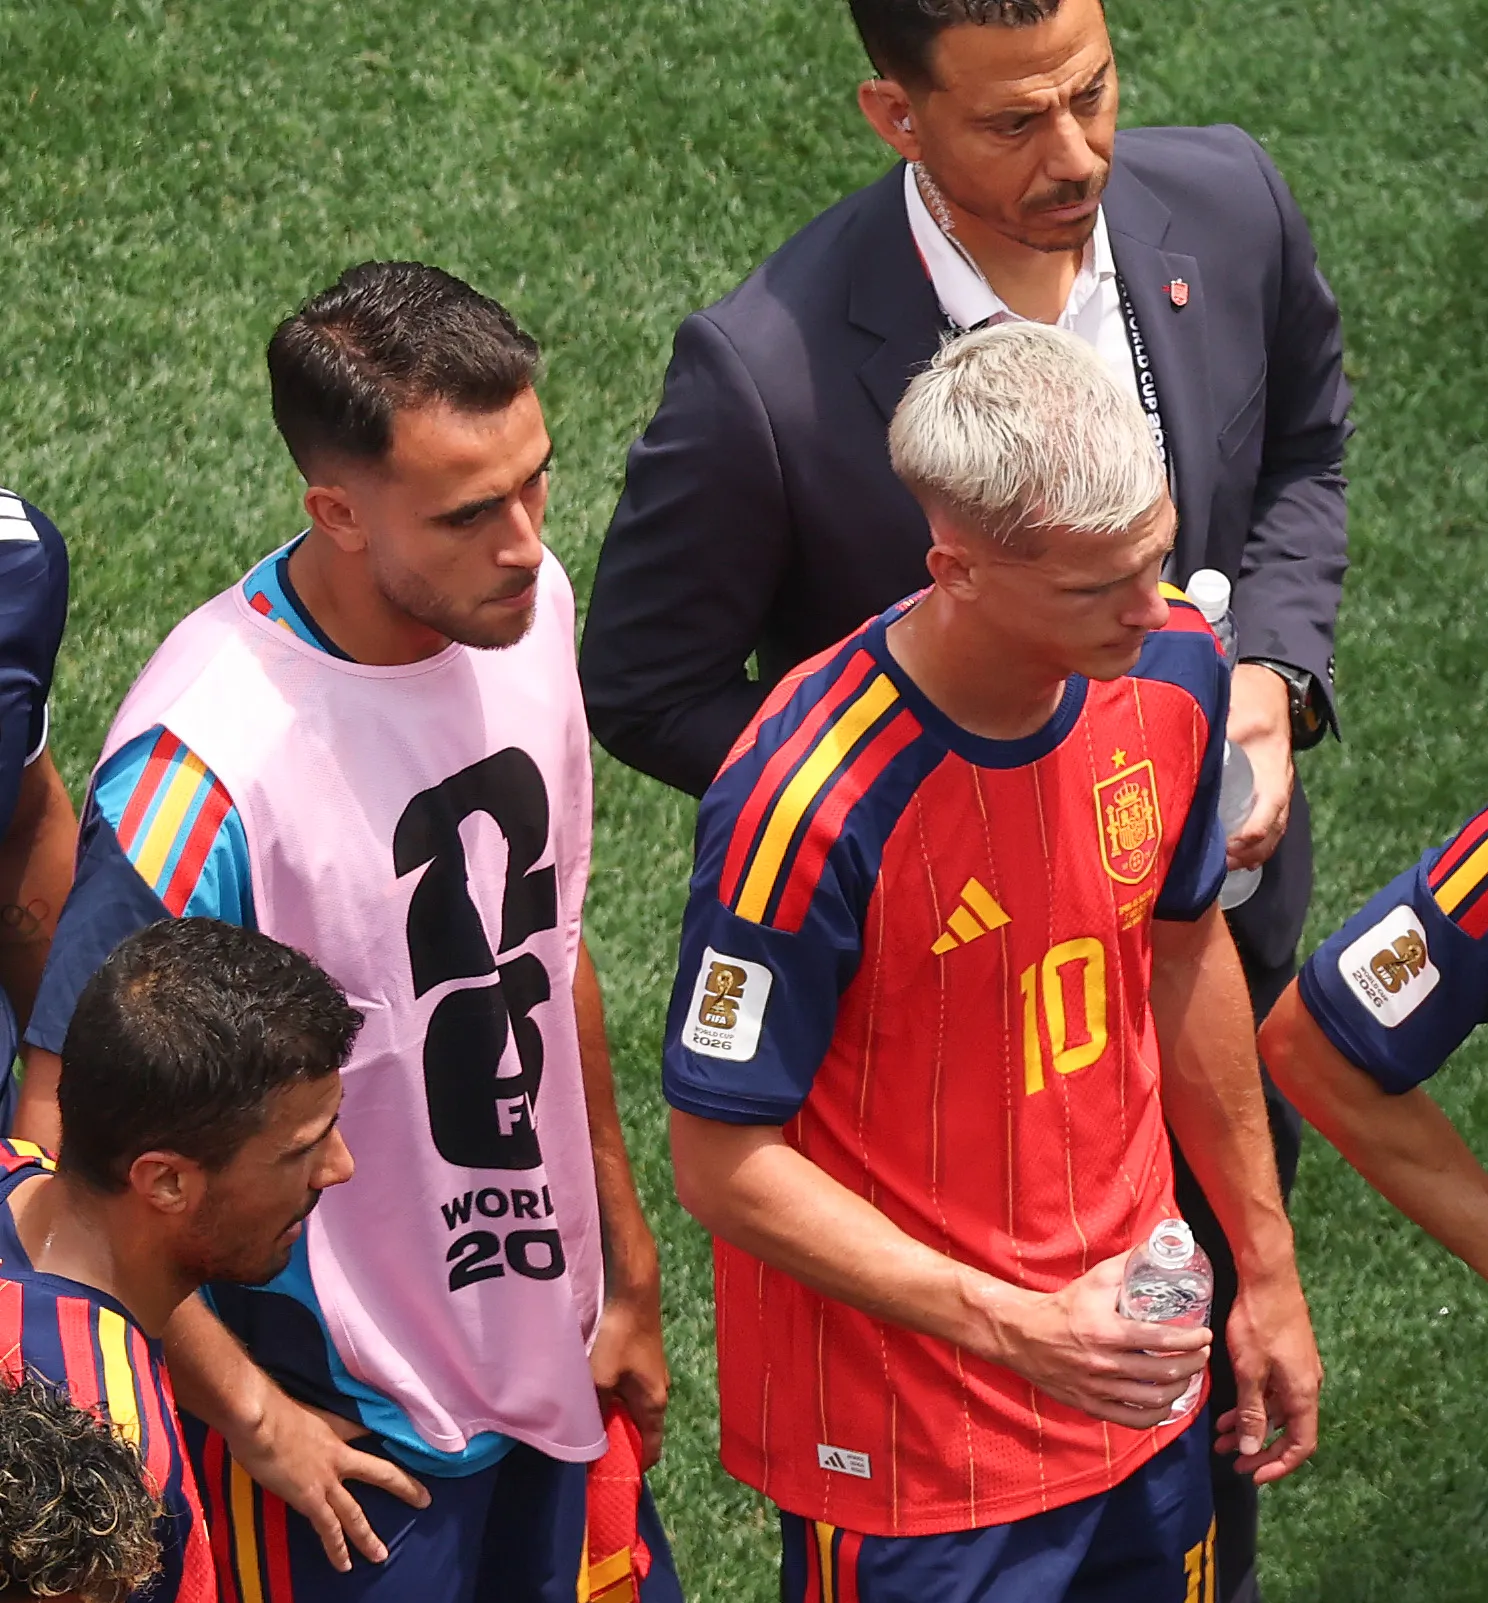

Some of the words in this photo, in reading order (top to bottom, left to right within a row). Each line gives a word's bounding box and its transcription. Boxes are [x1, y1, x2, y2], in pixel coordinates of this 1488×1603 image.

[1140, 371, 1160, 412] CUP
[1352, 970, 1385, 1009] 2026
[705, 1012, 727, 1025] FIFA
[1022, 938, 1108, 1095] 10
[692, 1033, 733, 1051] 2026
